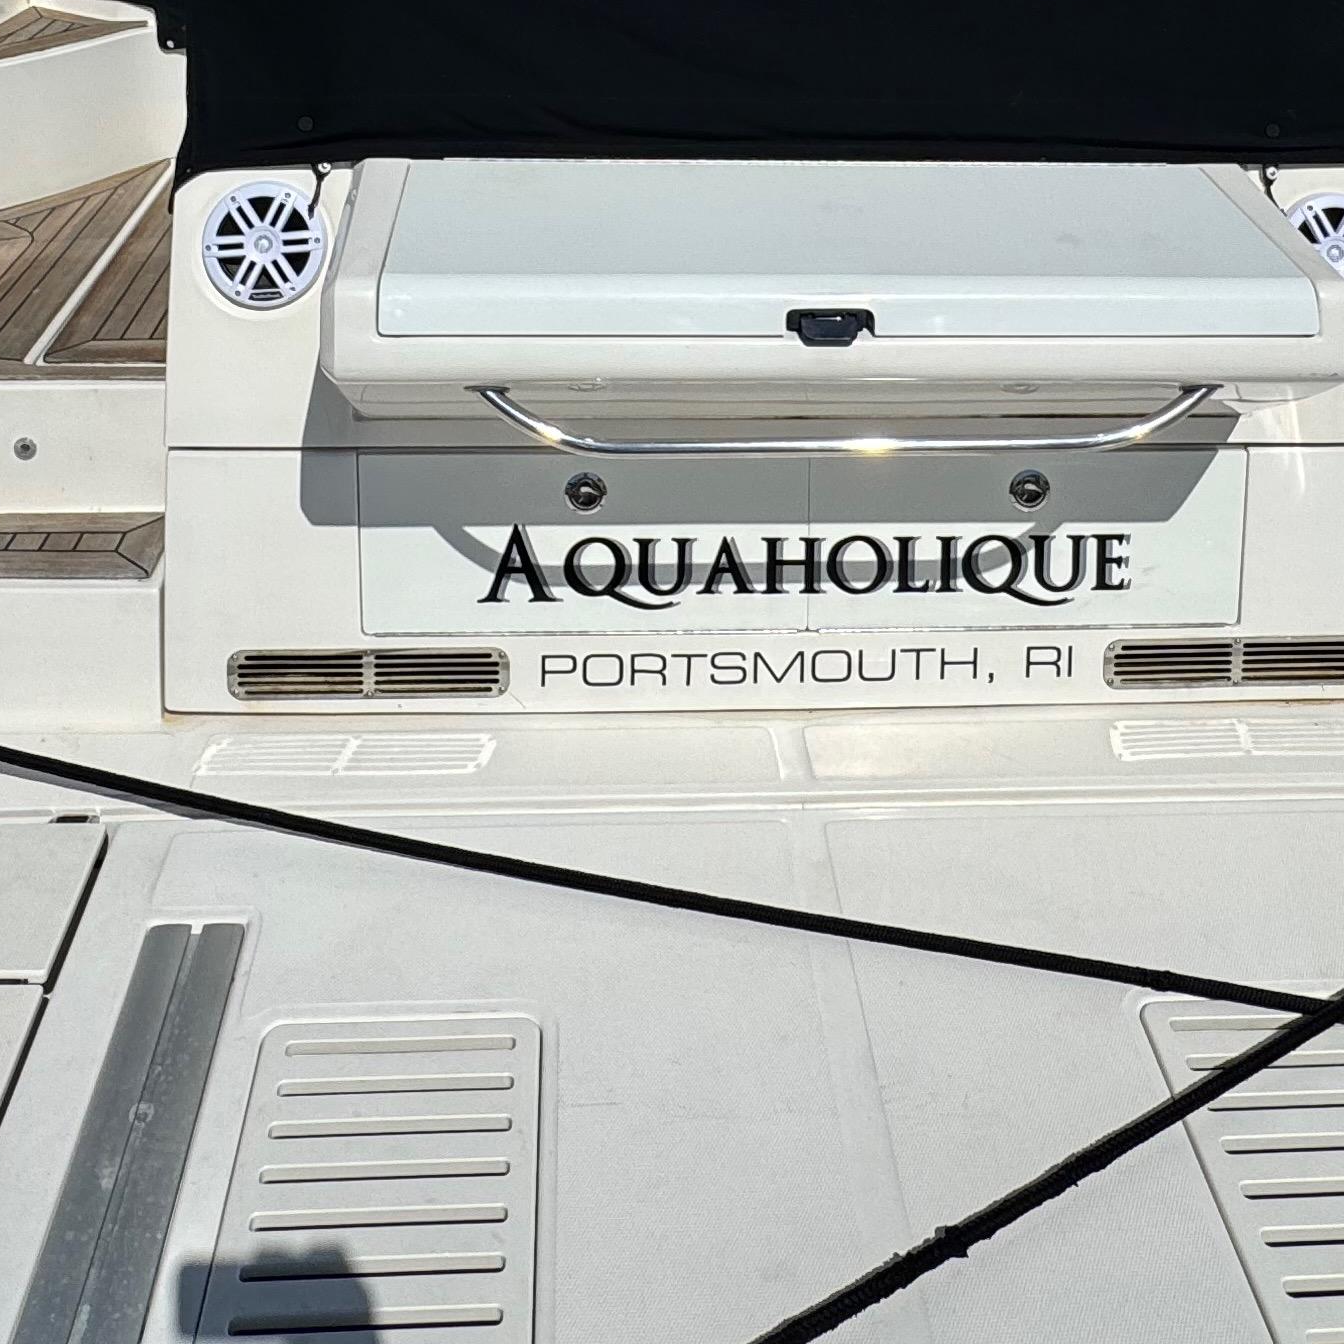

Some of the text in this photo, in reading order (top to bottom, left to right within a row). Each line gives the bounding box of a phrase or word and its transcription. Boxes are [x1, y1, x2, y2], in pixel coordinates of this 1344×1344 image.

[476, 523, 1132, 610] AQUAHOLIQUE
[540, 645, 1074, 687] PORTSMOUTH, RI
